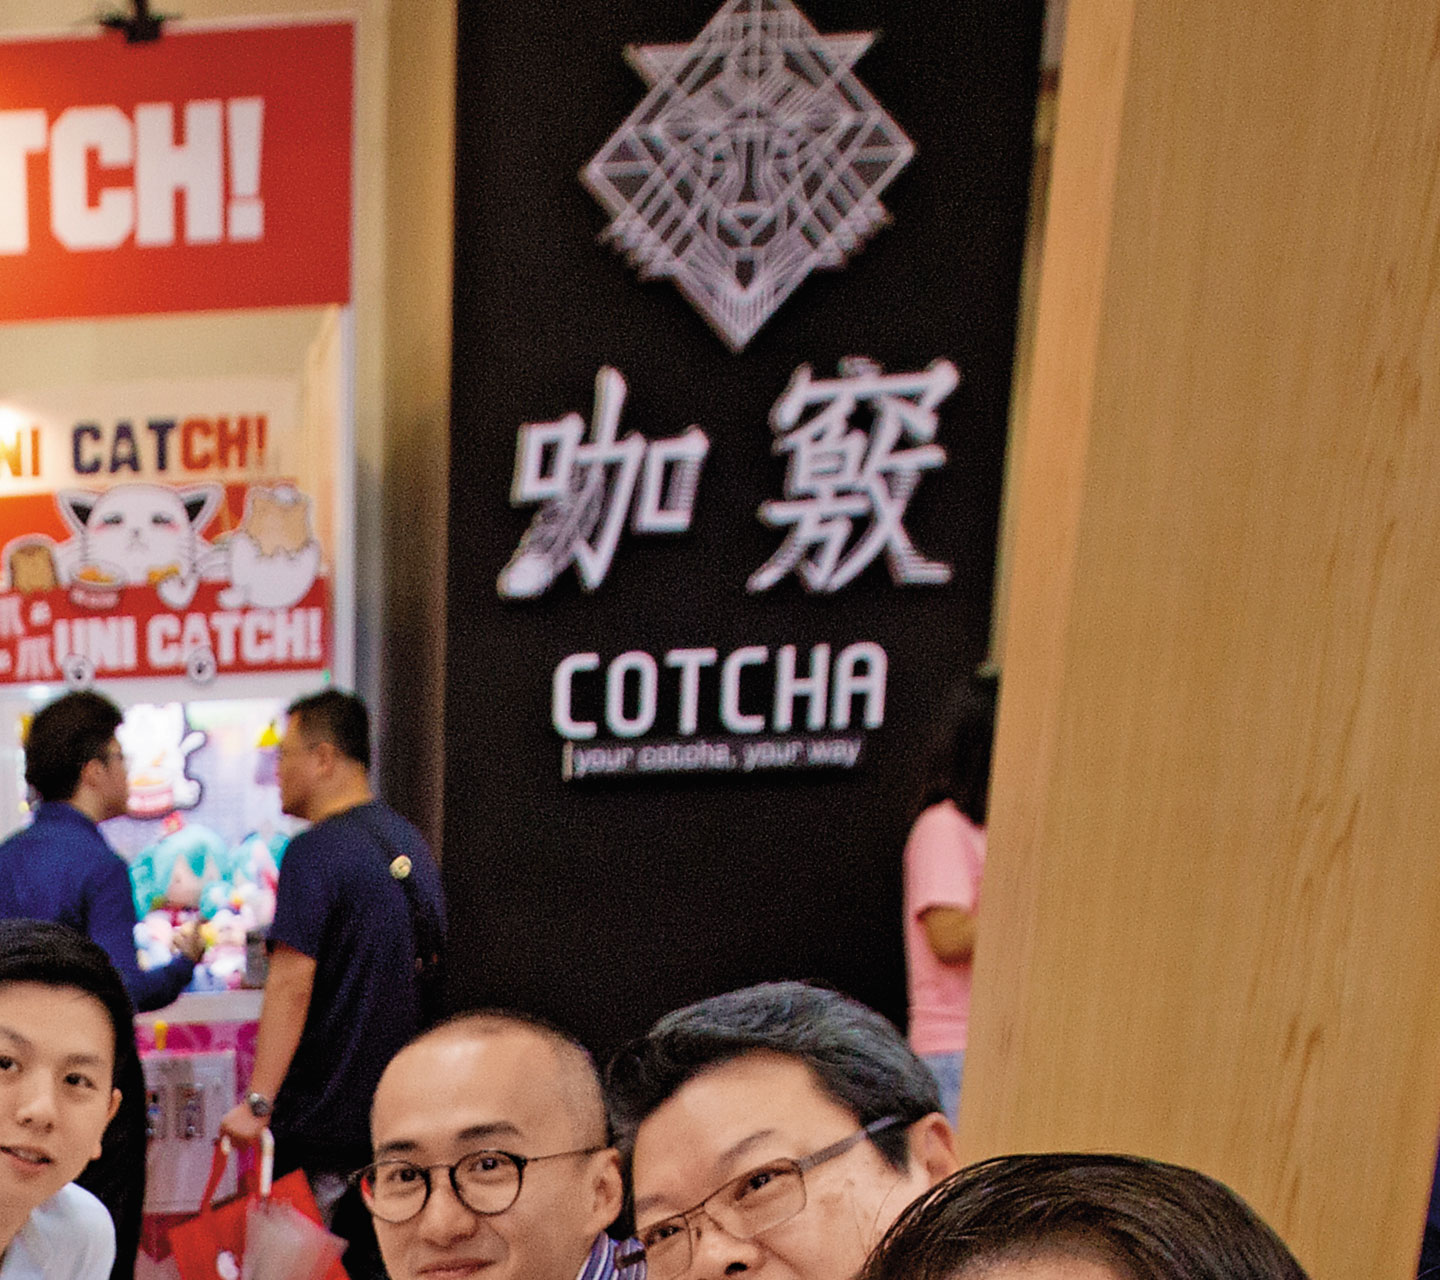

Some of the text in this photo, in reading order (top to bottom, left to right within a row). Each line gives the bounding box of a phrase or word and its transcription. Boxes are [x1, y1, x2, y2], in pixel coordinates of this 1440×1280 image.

[71, 414, 268, 476] CATCH!
[53, 606, 322, 672] UNI CATCH!
[551, 641, 889, 740] COTCHA
